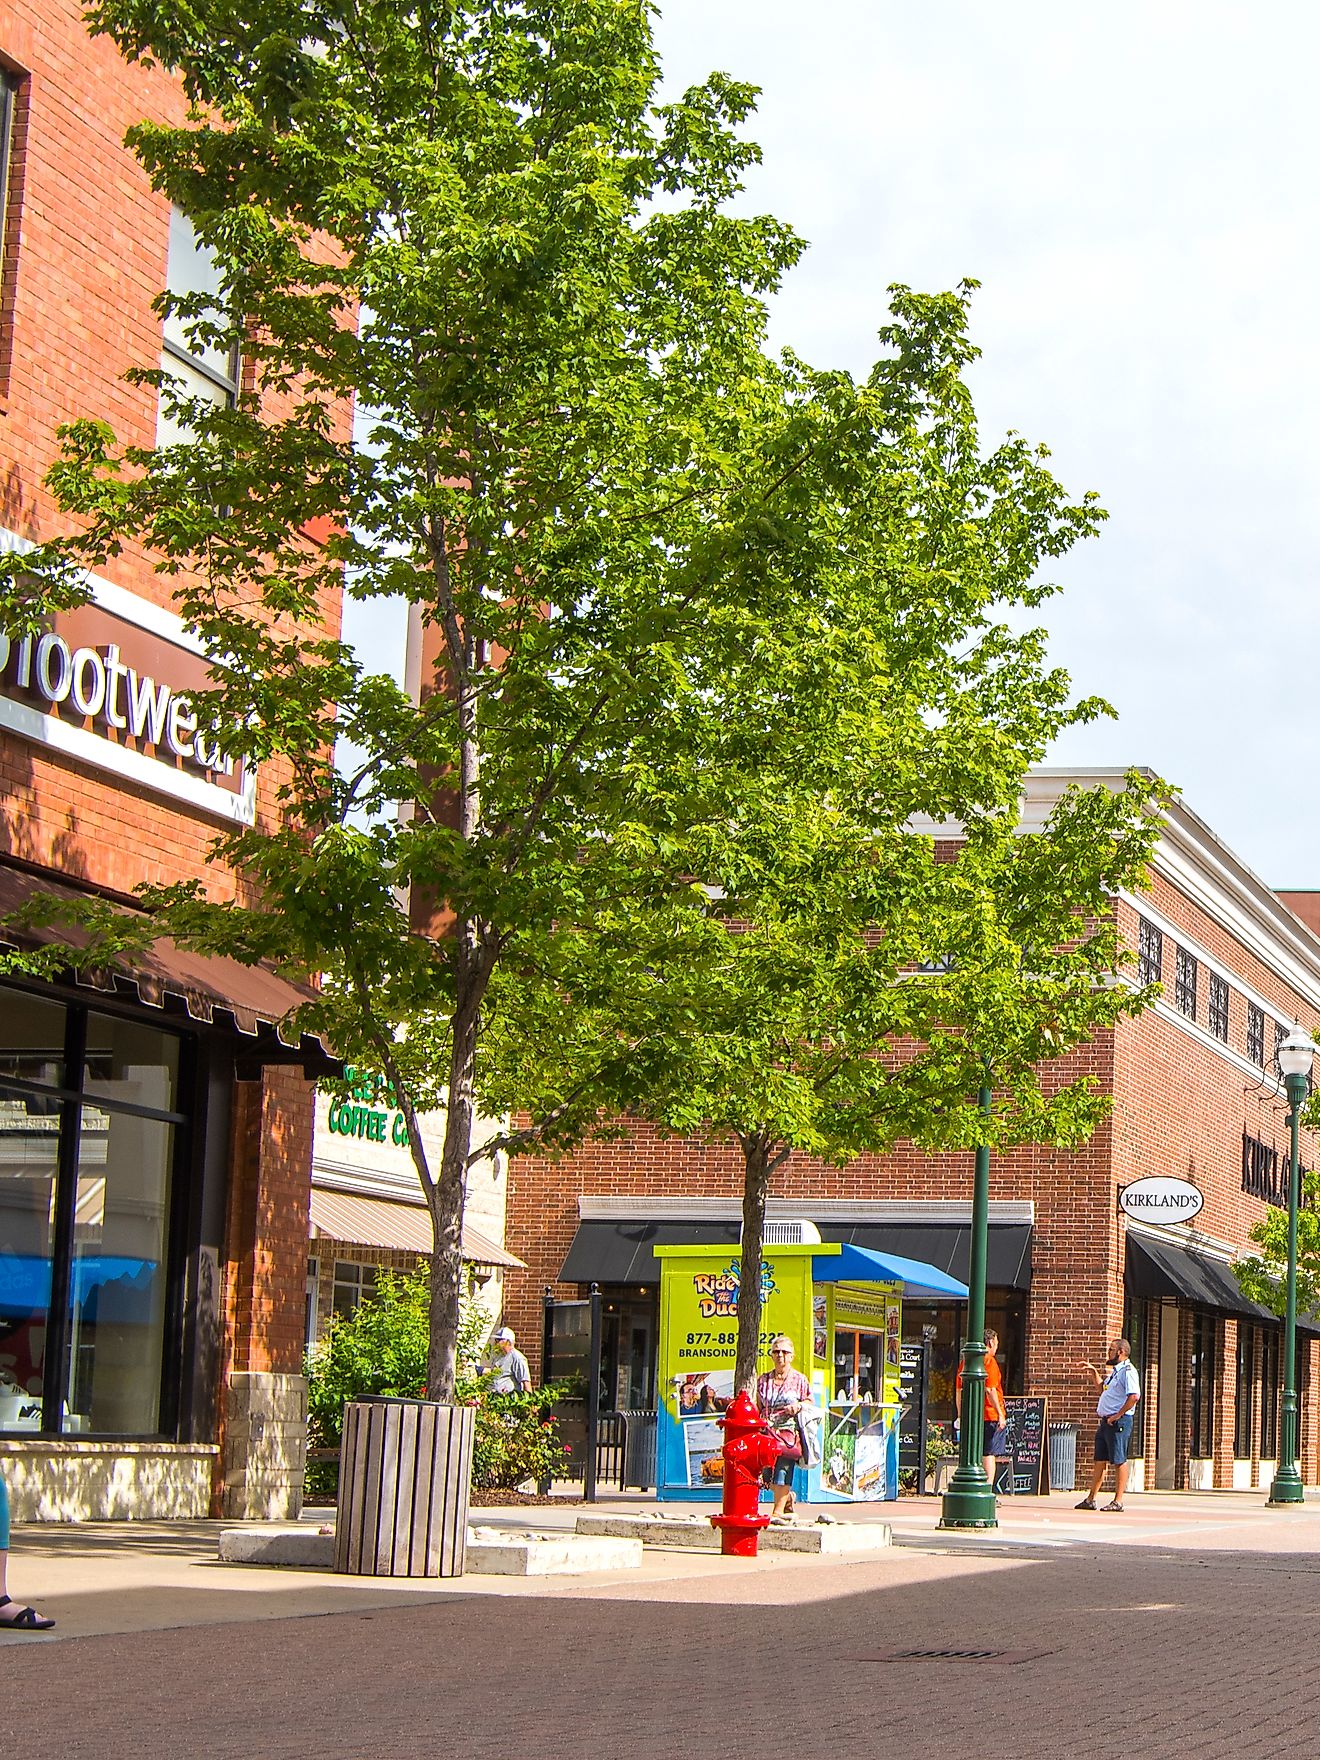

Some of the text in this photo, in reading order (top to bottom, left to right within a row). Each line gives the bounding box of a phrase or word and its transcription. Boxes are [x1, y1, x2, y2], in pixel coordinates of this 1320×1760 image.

[329, 1099, 388, 1142] COFFEE
[1125, 1192, 1199, 1209] KIRKLAND'S
[694, 1273, 737, 1295] Ride
[699, 1298, 738, 1318] Duc
